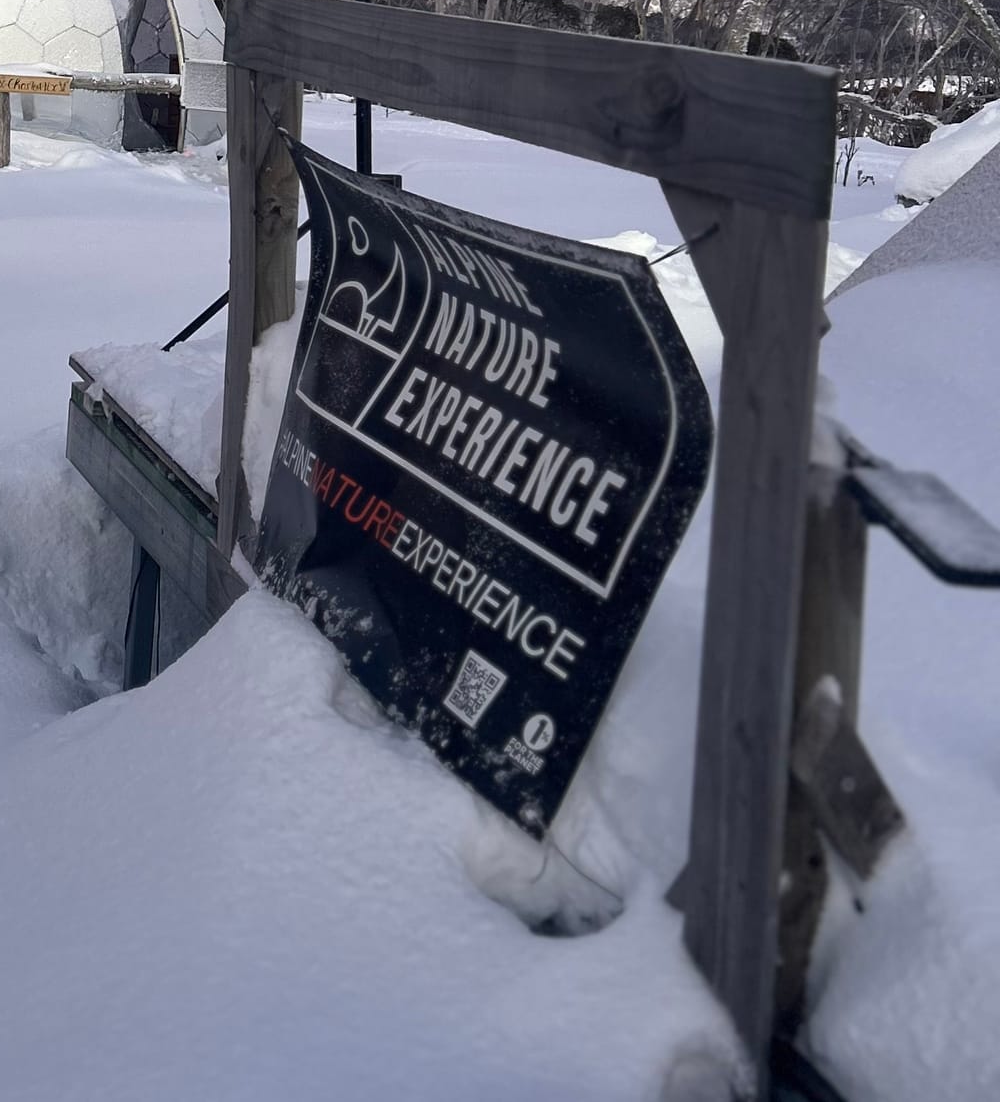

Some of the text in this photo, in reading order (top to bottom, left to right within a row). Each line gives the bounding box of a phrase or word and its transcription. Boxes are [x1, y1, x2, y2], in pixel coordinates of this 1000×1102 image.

[413, 224, 543, 317] ALPINE
[425, 292, 560, 408] NATURE
[384, 367, 627, 546] EXPERIENCE
[504, 745, 539, 775] PLANET
[509, 737, 544, 768] FOR THE
